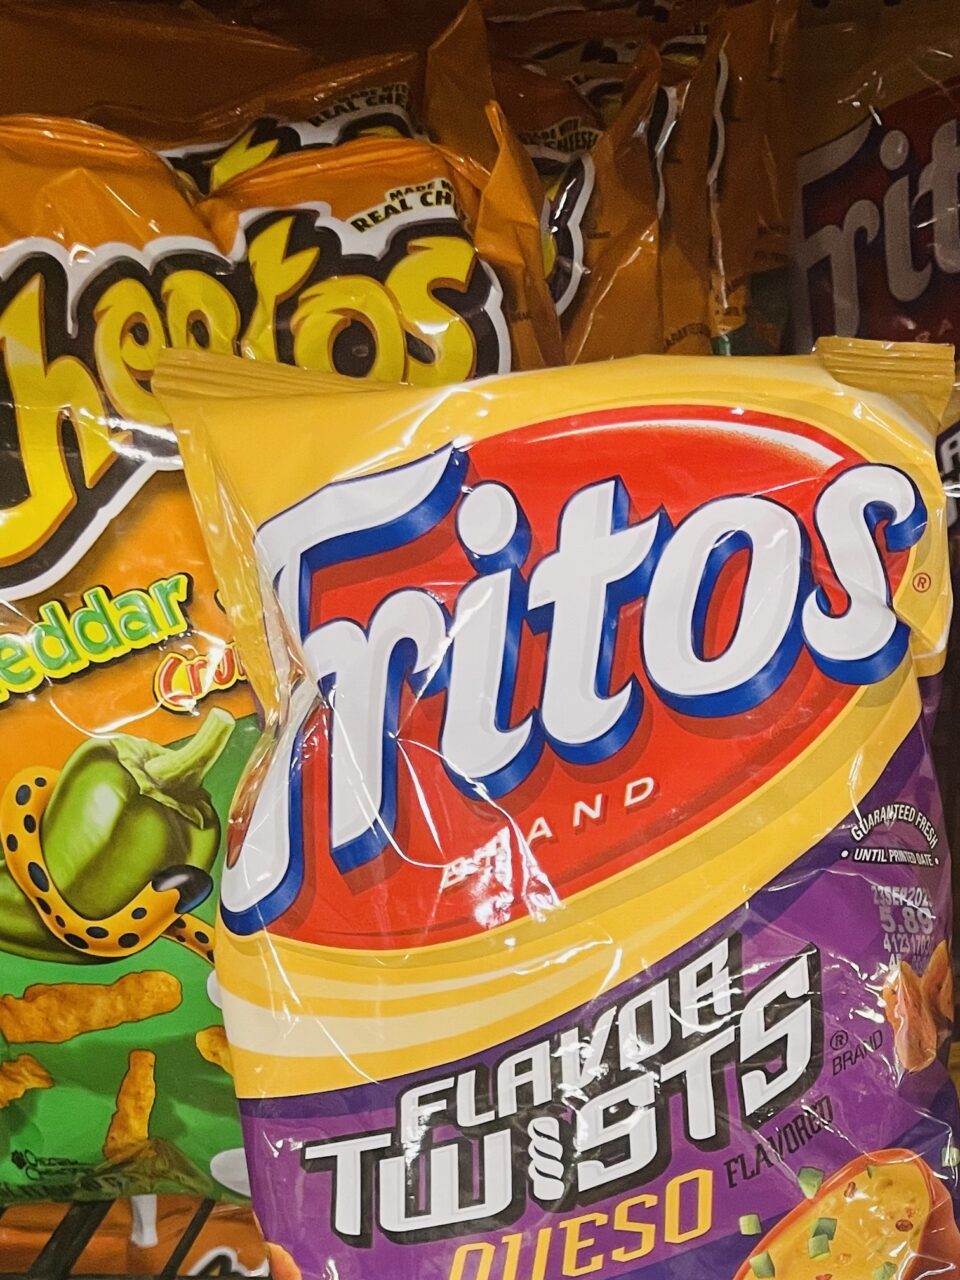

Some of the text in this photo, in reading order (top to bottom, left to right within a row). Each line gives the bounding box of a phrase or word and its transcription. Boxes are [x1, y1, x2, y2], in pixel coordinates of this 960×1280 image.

[351, 195, 413, 233] REAL
[389, 182, 435, 200] MADE
[0, 215, 476, 567] heetos
[0, 577, 184, 686] eddar
[222, 447, 914, 907] Fritos
[851, 803, 938, 848] GUARANTEED FRESH
[854, 848, 934, 866] UNTIL PRINTED DATE
[880, 904, 933, 935] 5.89
[398, 939, 738, 1138] FLAVOR
[832, 1030, 884, 1074] BRAND
[305, 949, 815, 1237] TWISTS
[725, 1096, 834, 1189] FLAVORED
